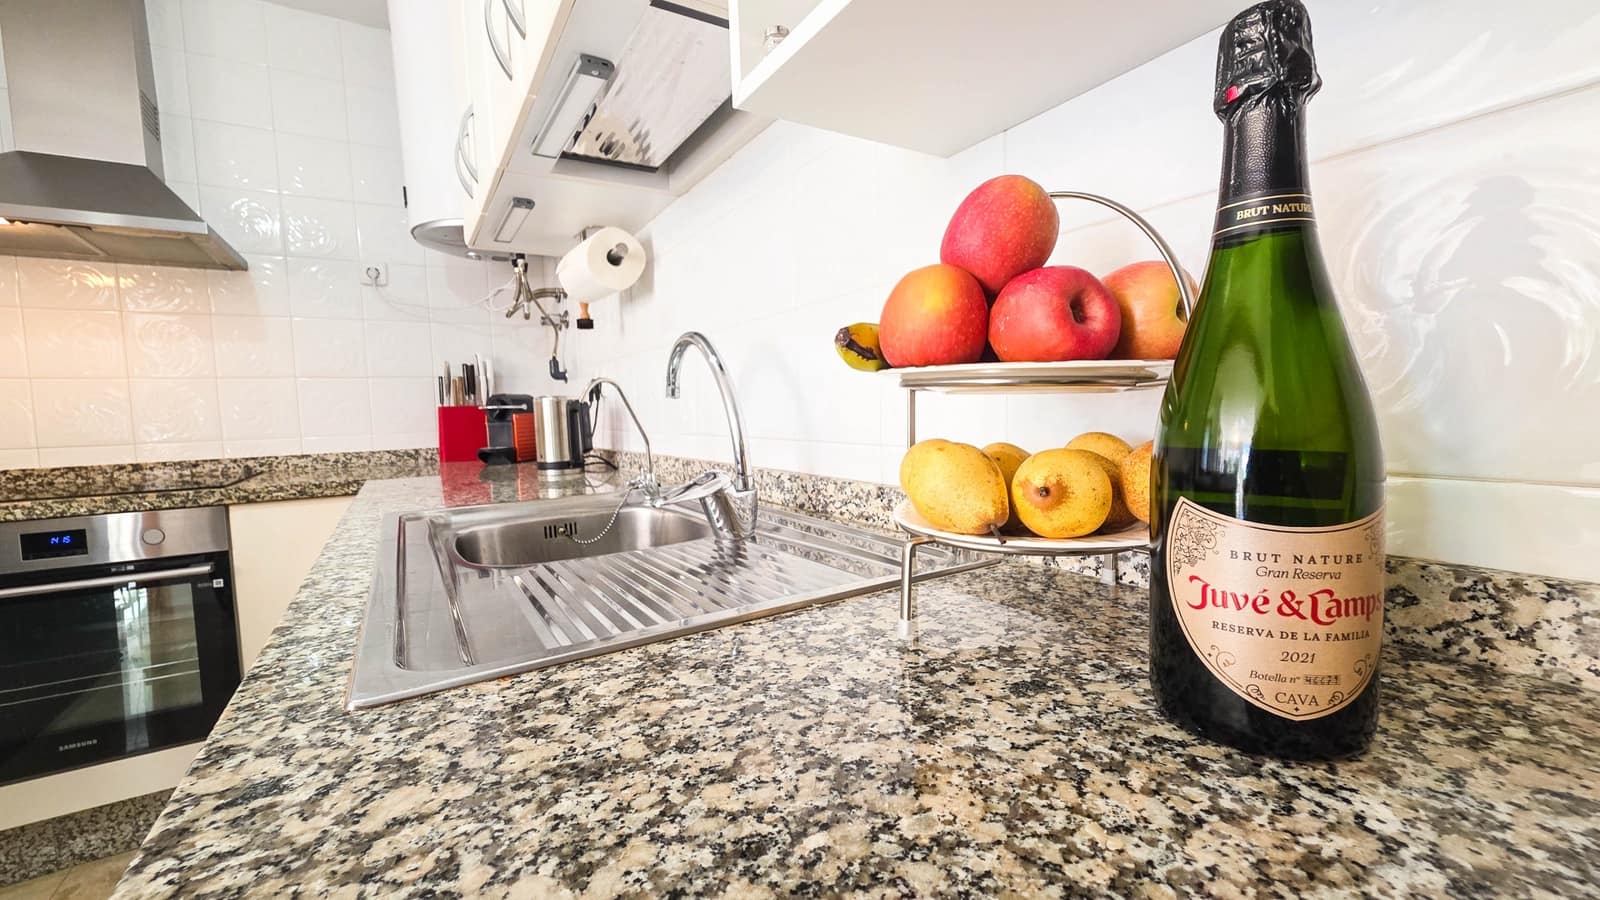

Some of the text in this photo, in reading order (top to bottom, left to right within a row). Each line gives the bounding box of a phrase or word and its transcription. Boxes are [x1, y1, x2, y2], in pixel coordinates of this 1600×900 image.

[1236, 205, 1270, 220] BRUT
[1230, 550, 1363, 565] BRUT NATURE
[1255, 566, 1342, 580] Gran Reserva
[1187, 575, 1382, 627] Juvé & Camps
[1212, 620, 1371, 642] RESERVA DE LA FAMILIA
[1280, 651, 1317, 664] 2021
[1249, 670, 1287, 683] Botella
[1275, 692, 1320, 707] CAVA
